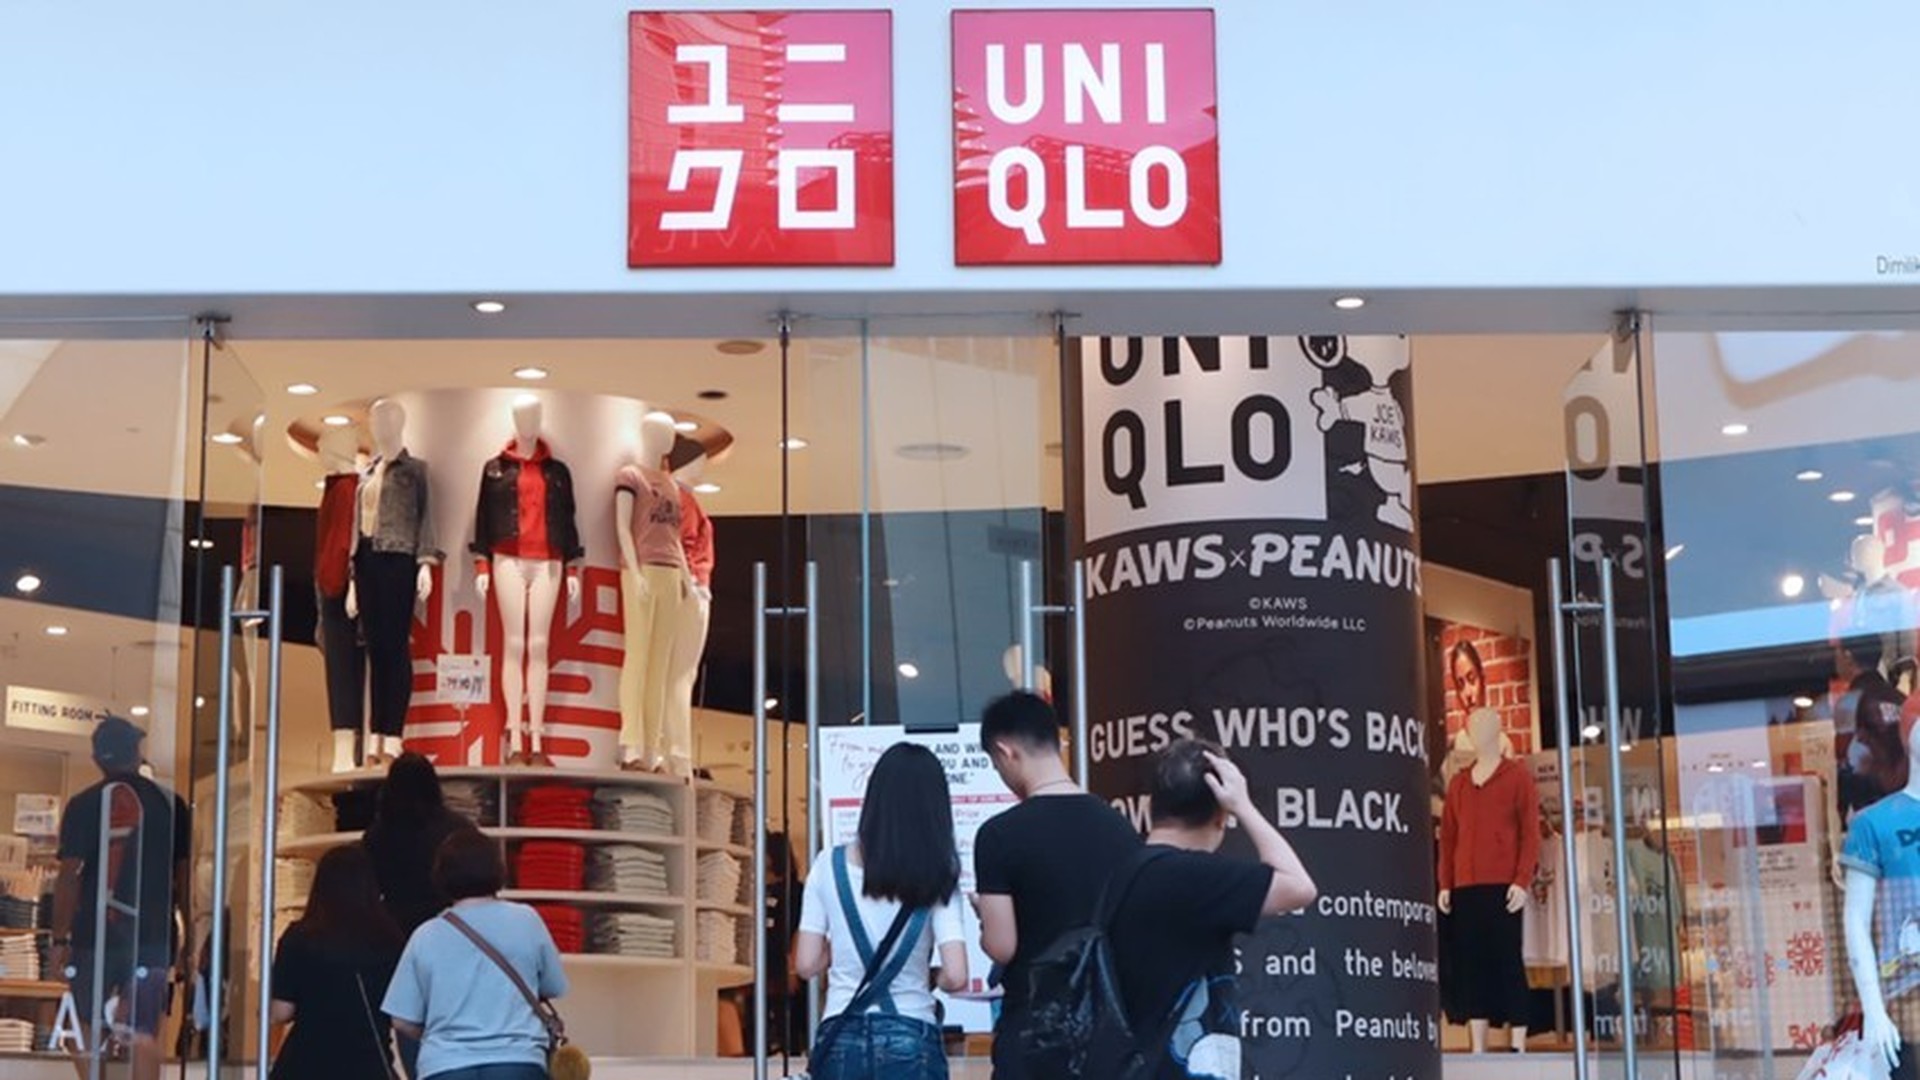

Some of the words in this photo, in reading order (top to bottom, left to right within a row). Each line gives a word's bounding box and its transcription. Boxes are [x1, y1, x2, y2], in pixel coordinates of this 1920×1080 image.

[667, 44, 855, 124] ユニ
[986, 43, 1166, 124] UNI
[658, 149, 855, 230] クロ
[986, 144, 1188, 245] QLO
[1101, 393, 1293, 510] QLO
[1085, 533, 1228, 600] KAWS
[1262, 614, 1339, 630] Worldwide
[1342, 617, 1367, 632] LLC
[12, 699, 57, 718] FITTING
[61, 706, 94, 722] ROOM
[1090, 710, 1195, 763] GUESS
[1213, 706, 1351, 749] WHO'S
[1276, 787, 1409, 834] BLACK.
[1265, 947, 1316, 976] and
[1344, 948, 1383, 977] the
[1240, 1009, 1312, 1038] from
[1335, 1009, 1421, 1040] Peanuts
